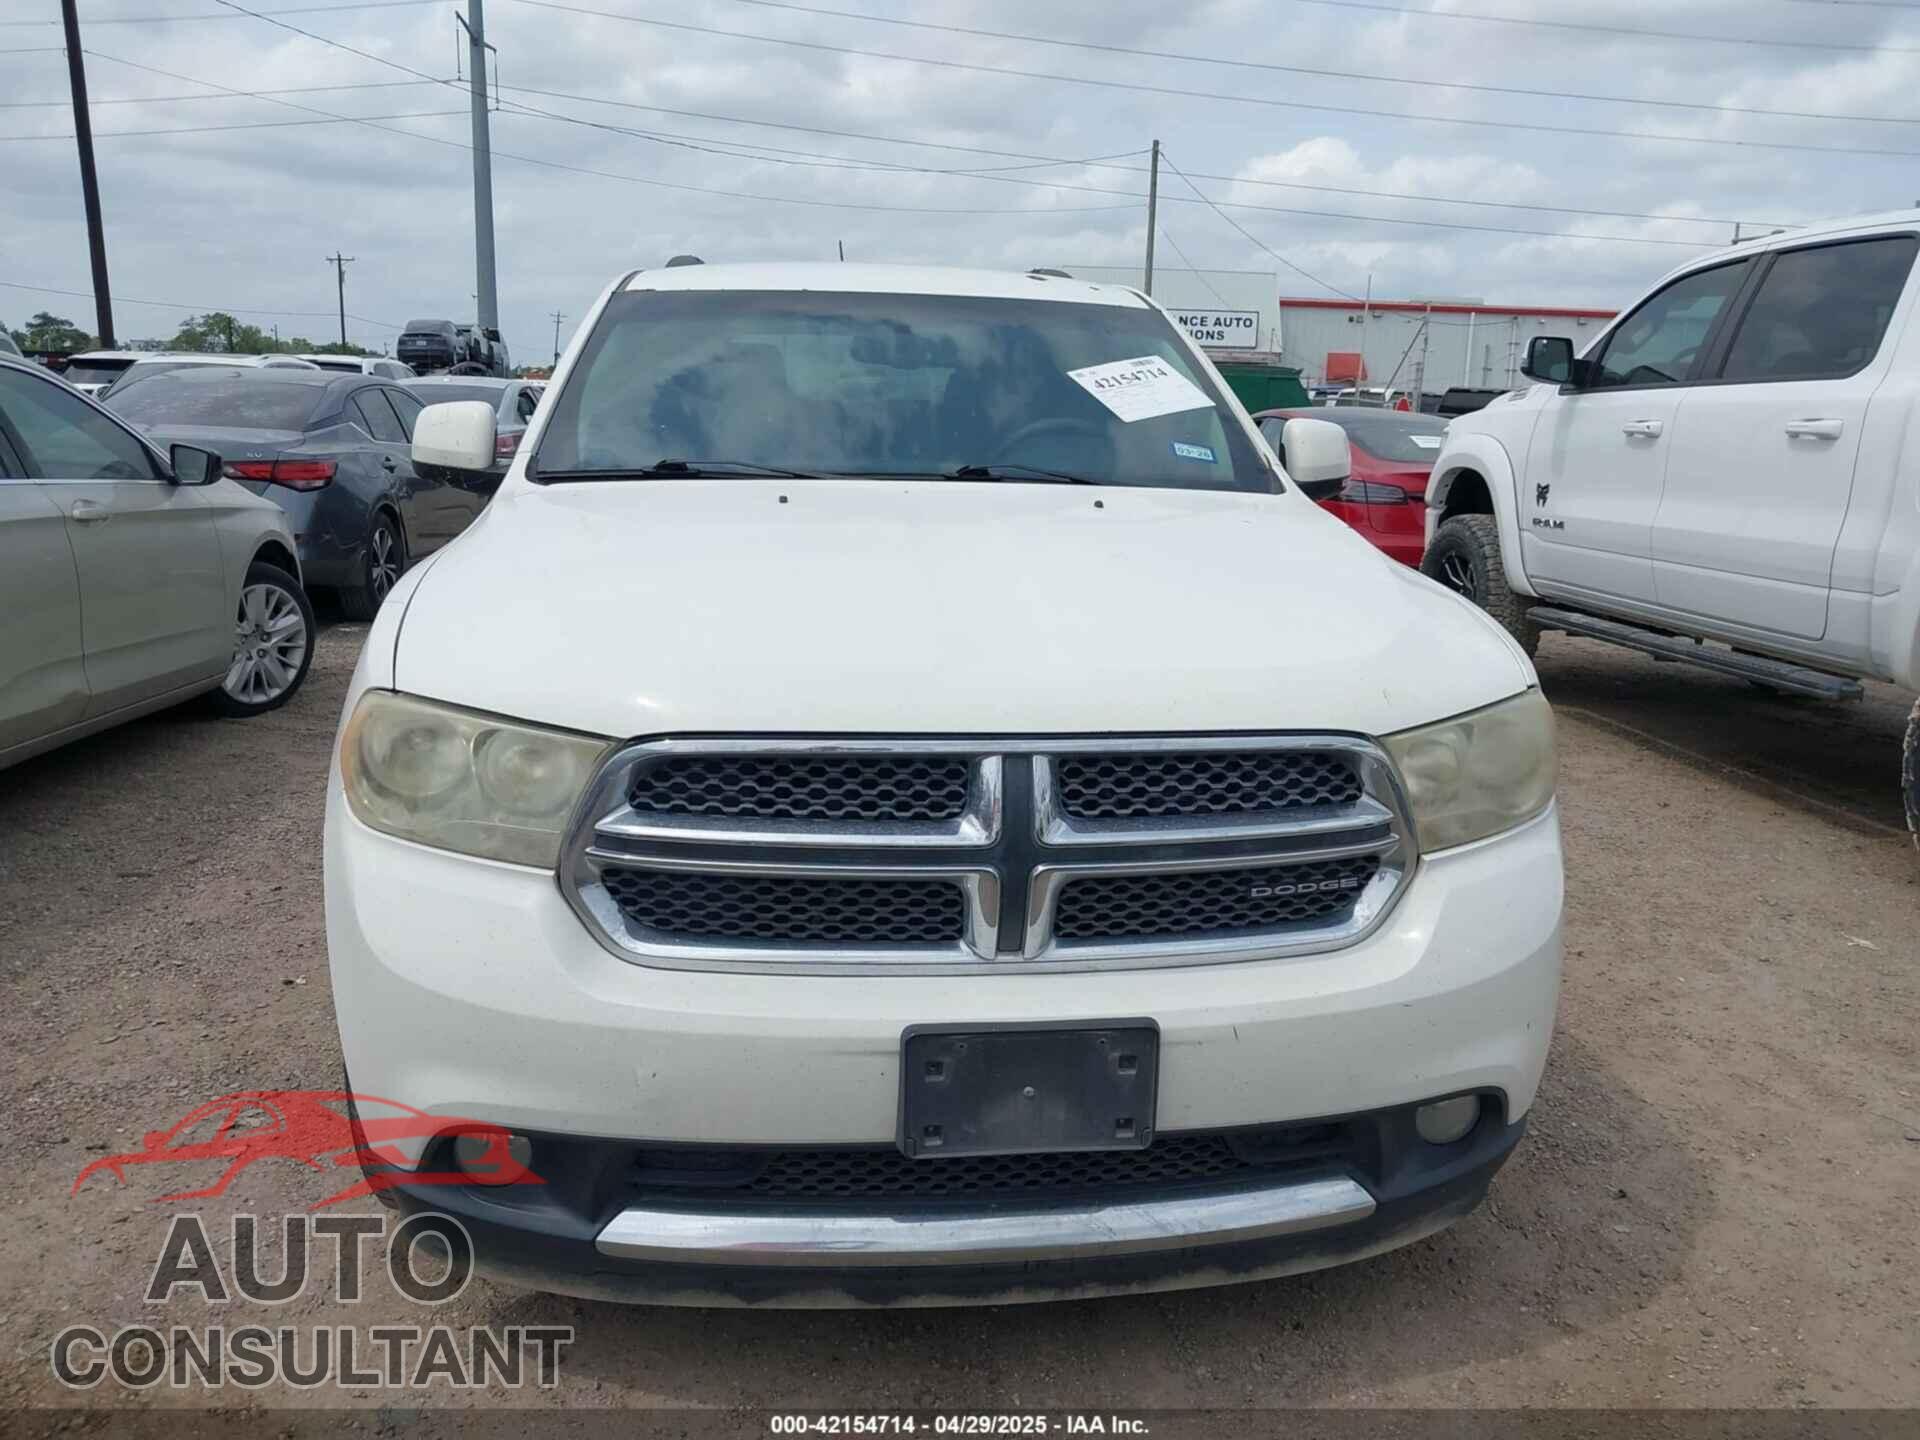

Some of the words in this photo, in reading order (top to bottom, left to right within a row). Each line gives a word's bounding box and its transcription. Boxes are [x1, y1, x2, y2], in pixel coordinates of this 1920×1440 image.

[1179, 315, 1208, 327] NCE
[1213, 317, 1253, 328] AUTO
[1094, 368, 1168, 389] 42154714
[1532, 517, 1565, 530] RAM
[1251, 877, 1359, 897] DODGE
